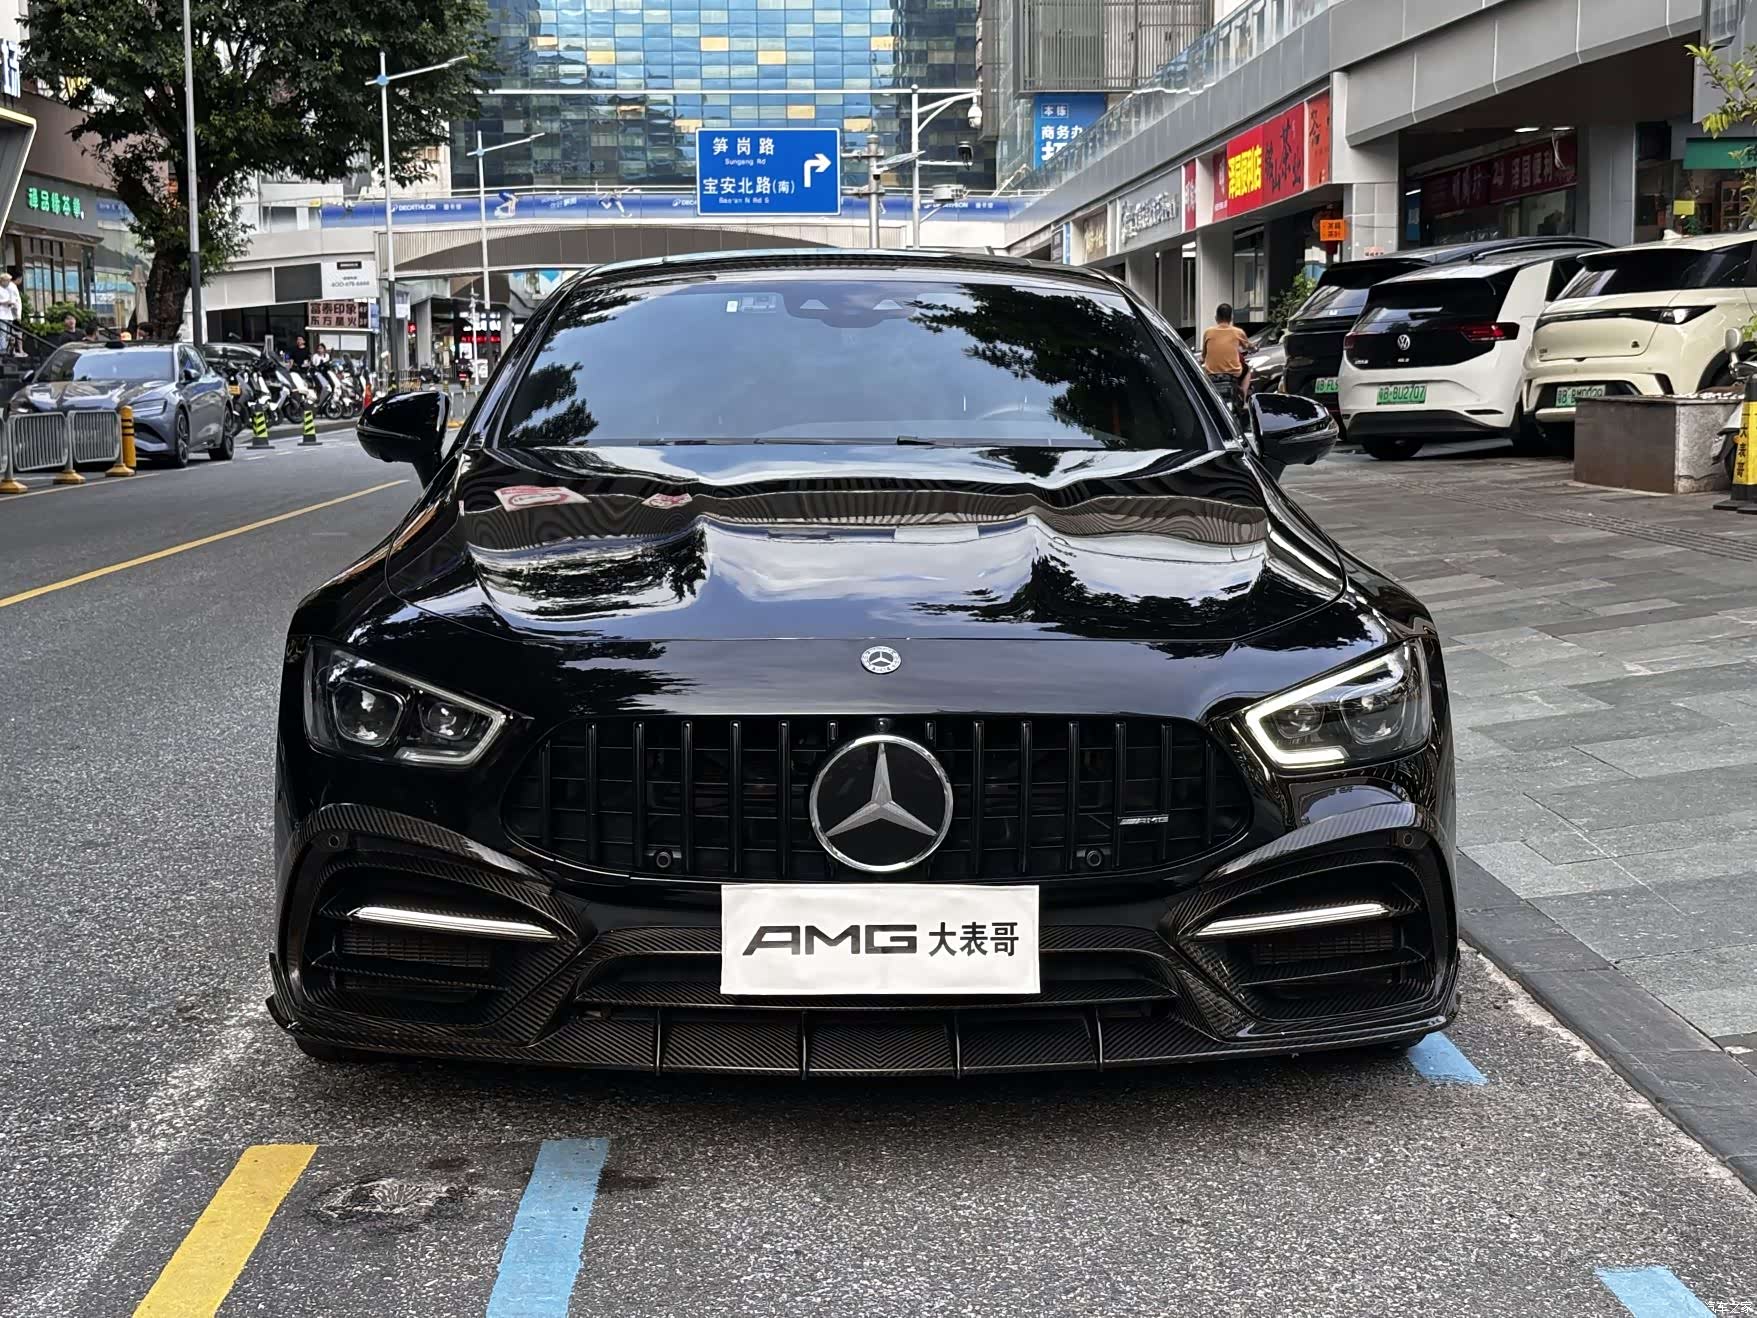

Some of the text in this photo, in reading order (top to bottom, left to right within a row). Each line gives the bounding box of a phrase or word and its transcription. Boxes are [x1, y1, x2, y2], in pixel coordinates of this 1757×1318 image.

[712, 136, 775, 156] 笋岗路
[742, 921, 1019, 957] AMG 大表哥
